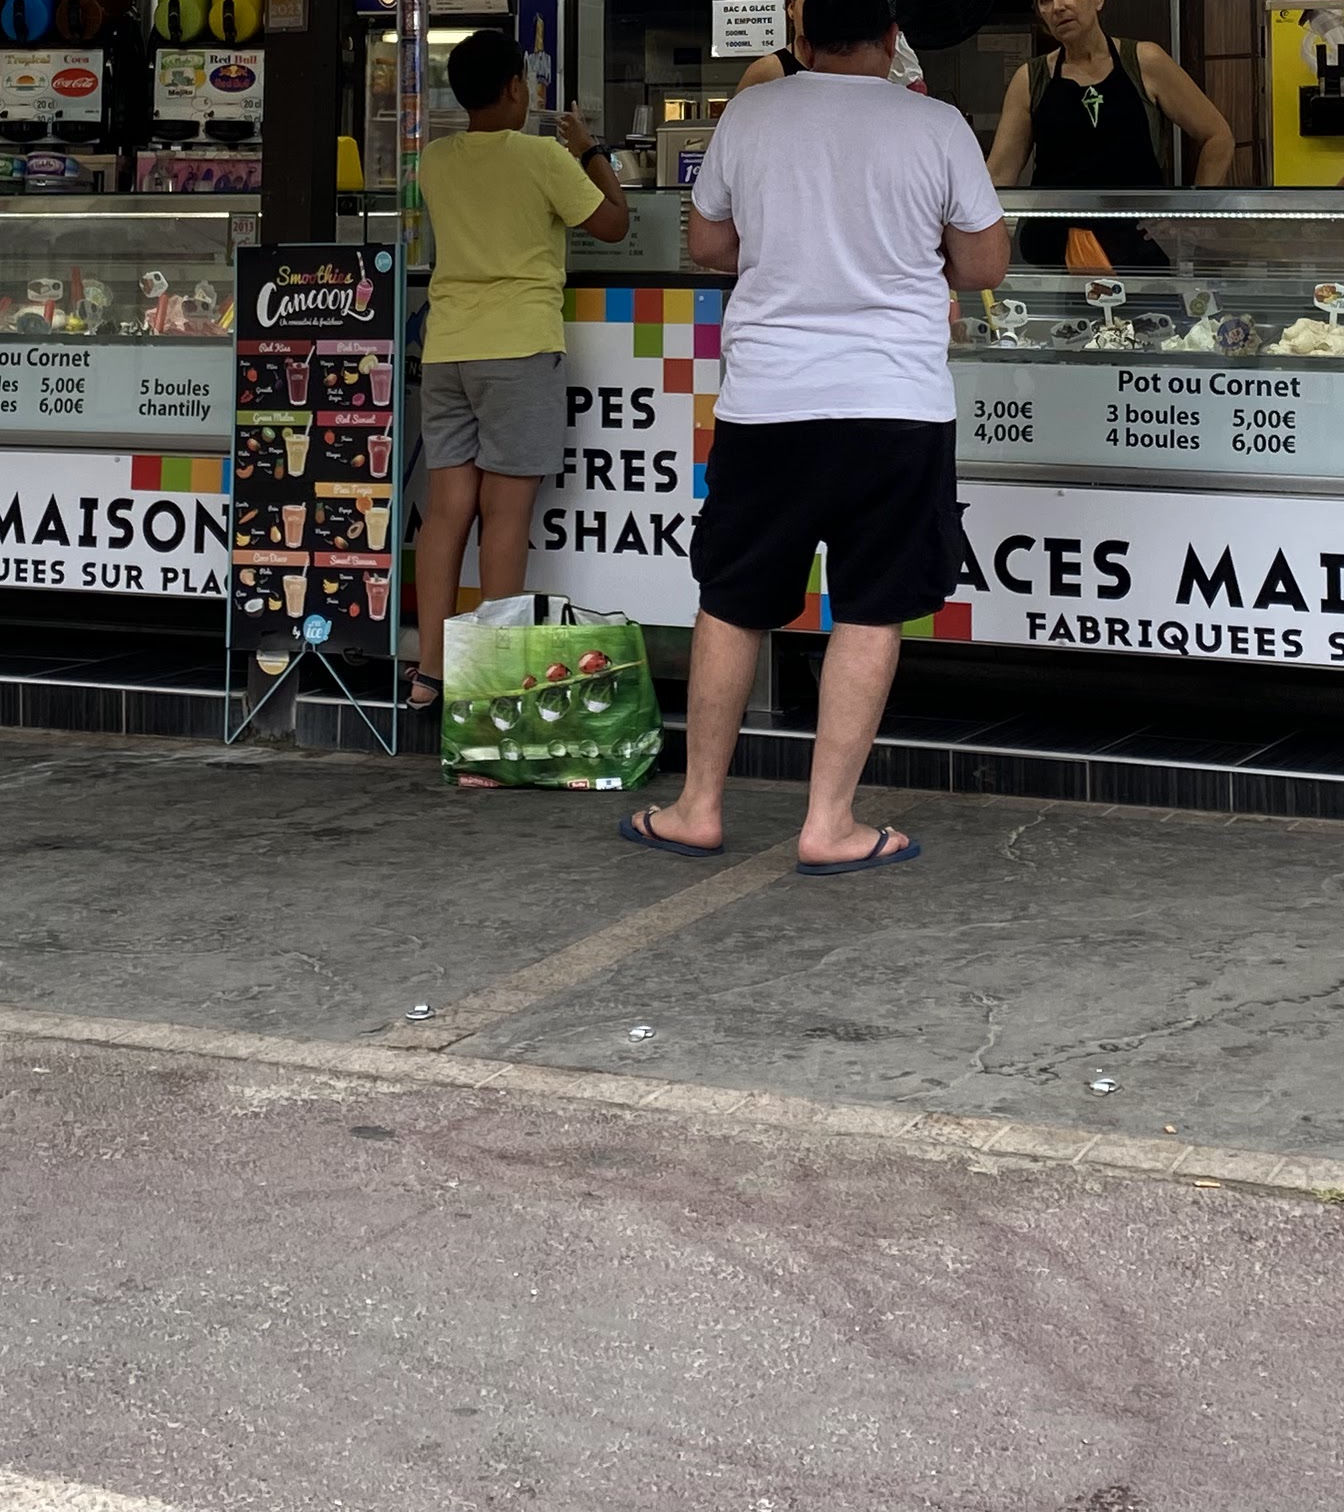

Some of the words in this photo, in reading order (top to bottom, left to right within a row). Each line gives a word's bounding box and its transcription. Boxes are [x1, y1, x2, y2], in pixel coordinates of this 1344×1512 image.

[734, 17, 773, 25] EMPORTE
[6, 55, 50, 65] Tropical
[64, 55, 89, 64] Coca
[210, 55, 230, 64] Red
[235, 55, 256, 64] Bull
[37, 101, 46, 109] 20
[48, 101, 55, 109] cl
[244, 100, 253, 108] 20
[255, 100, 261, 108] cl
[234, 221, 254, 232] 2013
[277, 264, 353, 286] Smoothies
[257, 282, 374, 327] Cancoon
[26, 347, 90, 368] Cornet
[40, 377, 85, 396] 5,00€
[140, 380, 149, 396] 5
[153, 379, 210, 398] boules
[1117, 371, 1156, 394] Pot
[1161, 376, 1202, 395] ou
[1209, 373, 1301, 399] Cornet
[39, 398, 84, 416] 6,00€
[139, 399, 211, 420] chantilly
[973, 400, 1034, 421] 3,00€
[1106, 406, 1117, 425] 3
[1125, 405, 1200, 427] boules
[1232, 408, 1297, 431] 5,00€
[973, 424, 1034, 445] 4,00€
[1105, 429, 1118, 448] 4
[1125, 429, 1200, 451] boules
[1232, 433, 1297, 455] 6,00€
[528, 507, 703, 558] SHAK
[82, 561, 144, 590] SUR
[161, 568, 229, 596] PLA
[1026, 611, 1303, 659] FABRIQUEES
